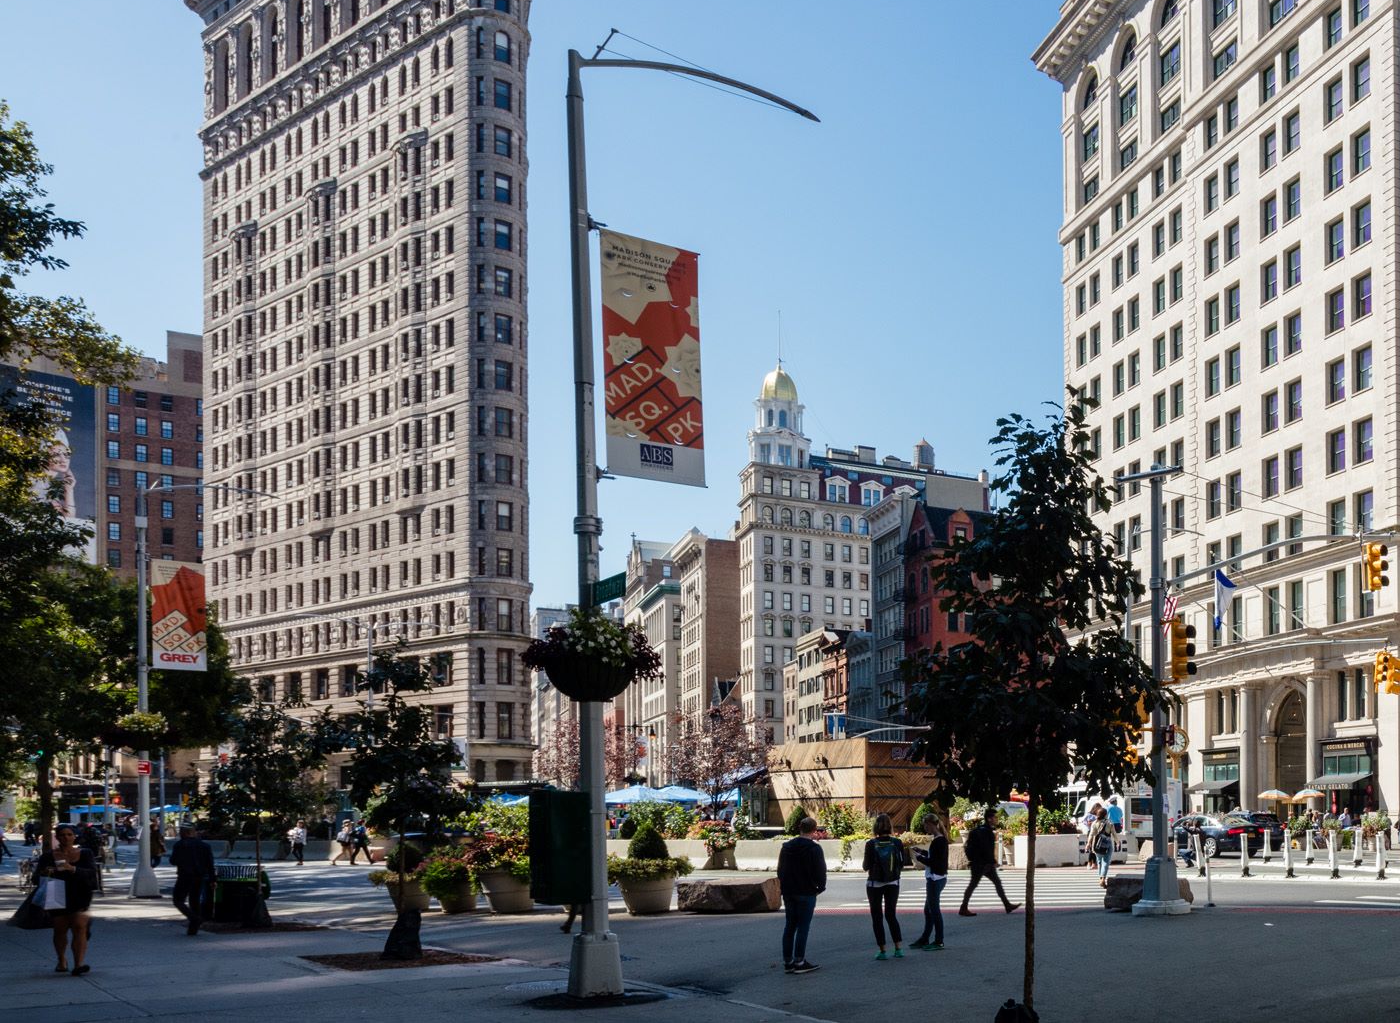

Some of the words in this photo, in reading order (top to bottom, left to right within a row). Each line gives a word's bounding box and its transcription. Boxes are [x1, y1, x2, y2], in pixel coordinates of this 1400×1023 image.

[612, 245, 652, 260] MADISON
[20, 379, 71, 394] OMEONE'S
[605, 362, 662, 406] MAD.
[624, 400, 669, 430] SQ.
[666, 411, 702, 442] PK
[641, 447, 673, 464] ABS
[163, 633, 188, 649] SQ.
[186, 637, 205, 651] PK
[160, 652, 200, 664] GREY
